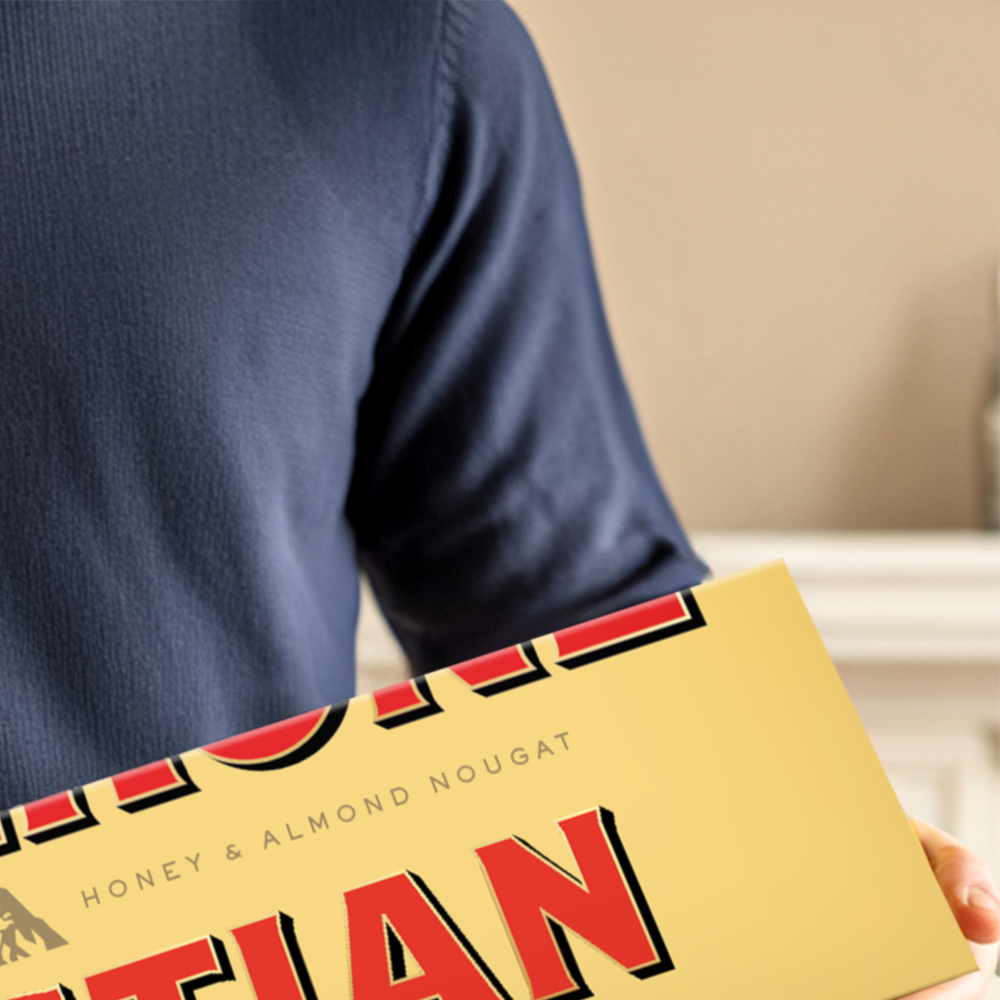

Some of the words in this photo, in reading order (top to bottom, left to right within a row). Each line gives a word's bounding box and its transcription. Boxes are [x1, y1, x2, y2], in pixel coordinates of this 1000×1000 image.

[79, 851, 202, 910] HONEY
[224, 843, 244, 862] &
[262, 785, 411, 851] ALMOND
[428, 730, 571, 795] NOUGAT
